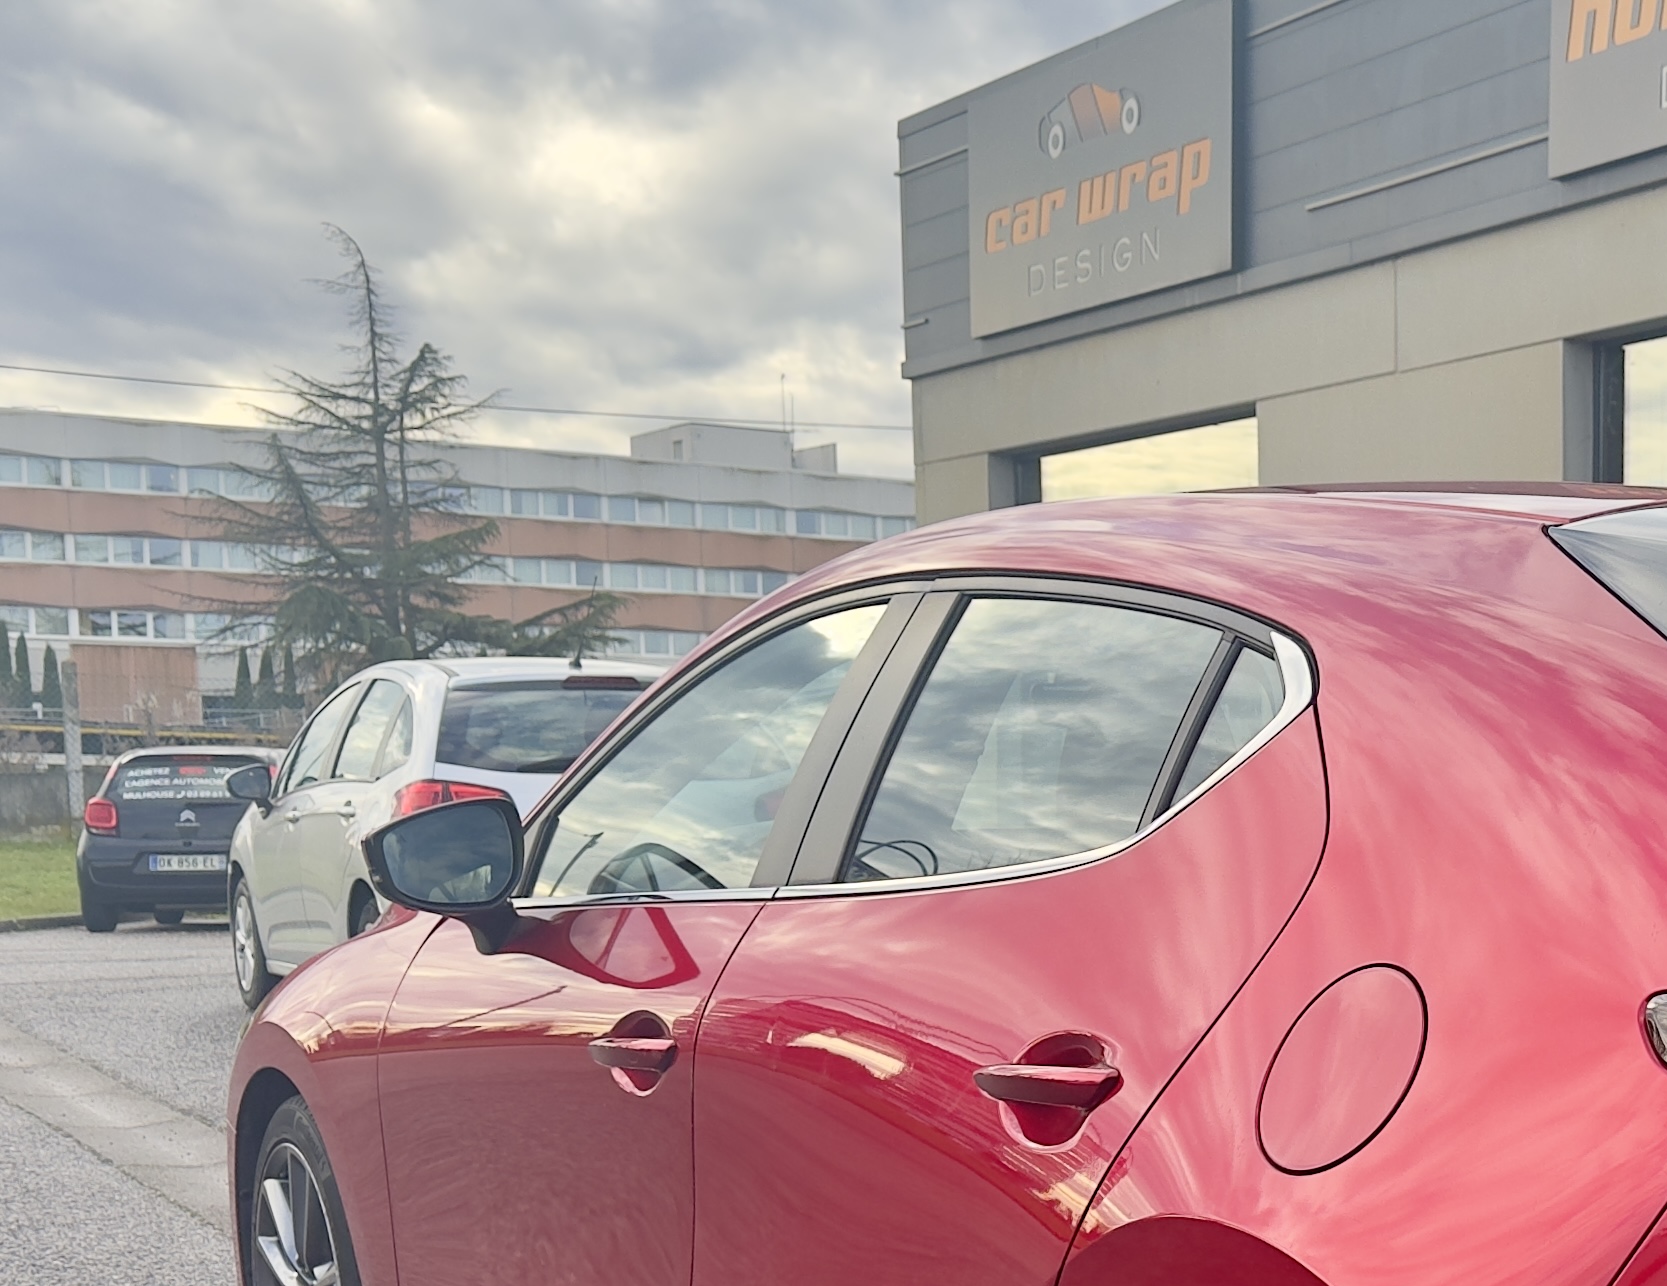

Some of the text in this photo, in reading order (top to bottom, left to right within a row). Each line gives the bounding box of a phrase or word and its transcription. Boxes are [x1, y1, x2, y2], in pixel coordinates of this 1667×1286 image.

[984, 137, 1212, 254] car wrap
[1027, 227, 1161, 297] DESIGN
